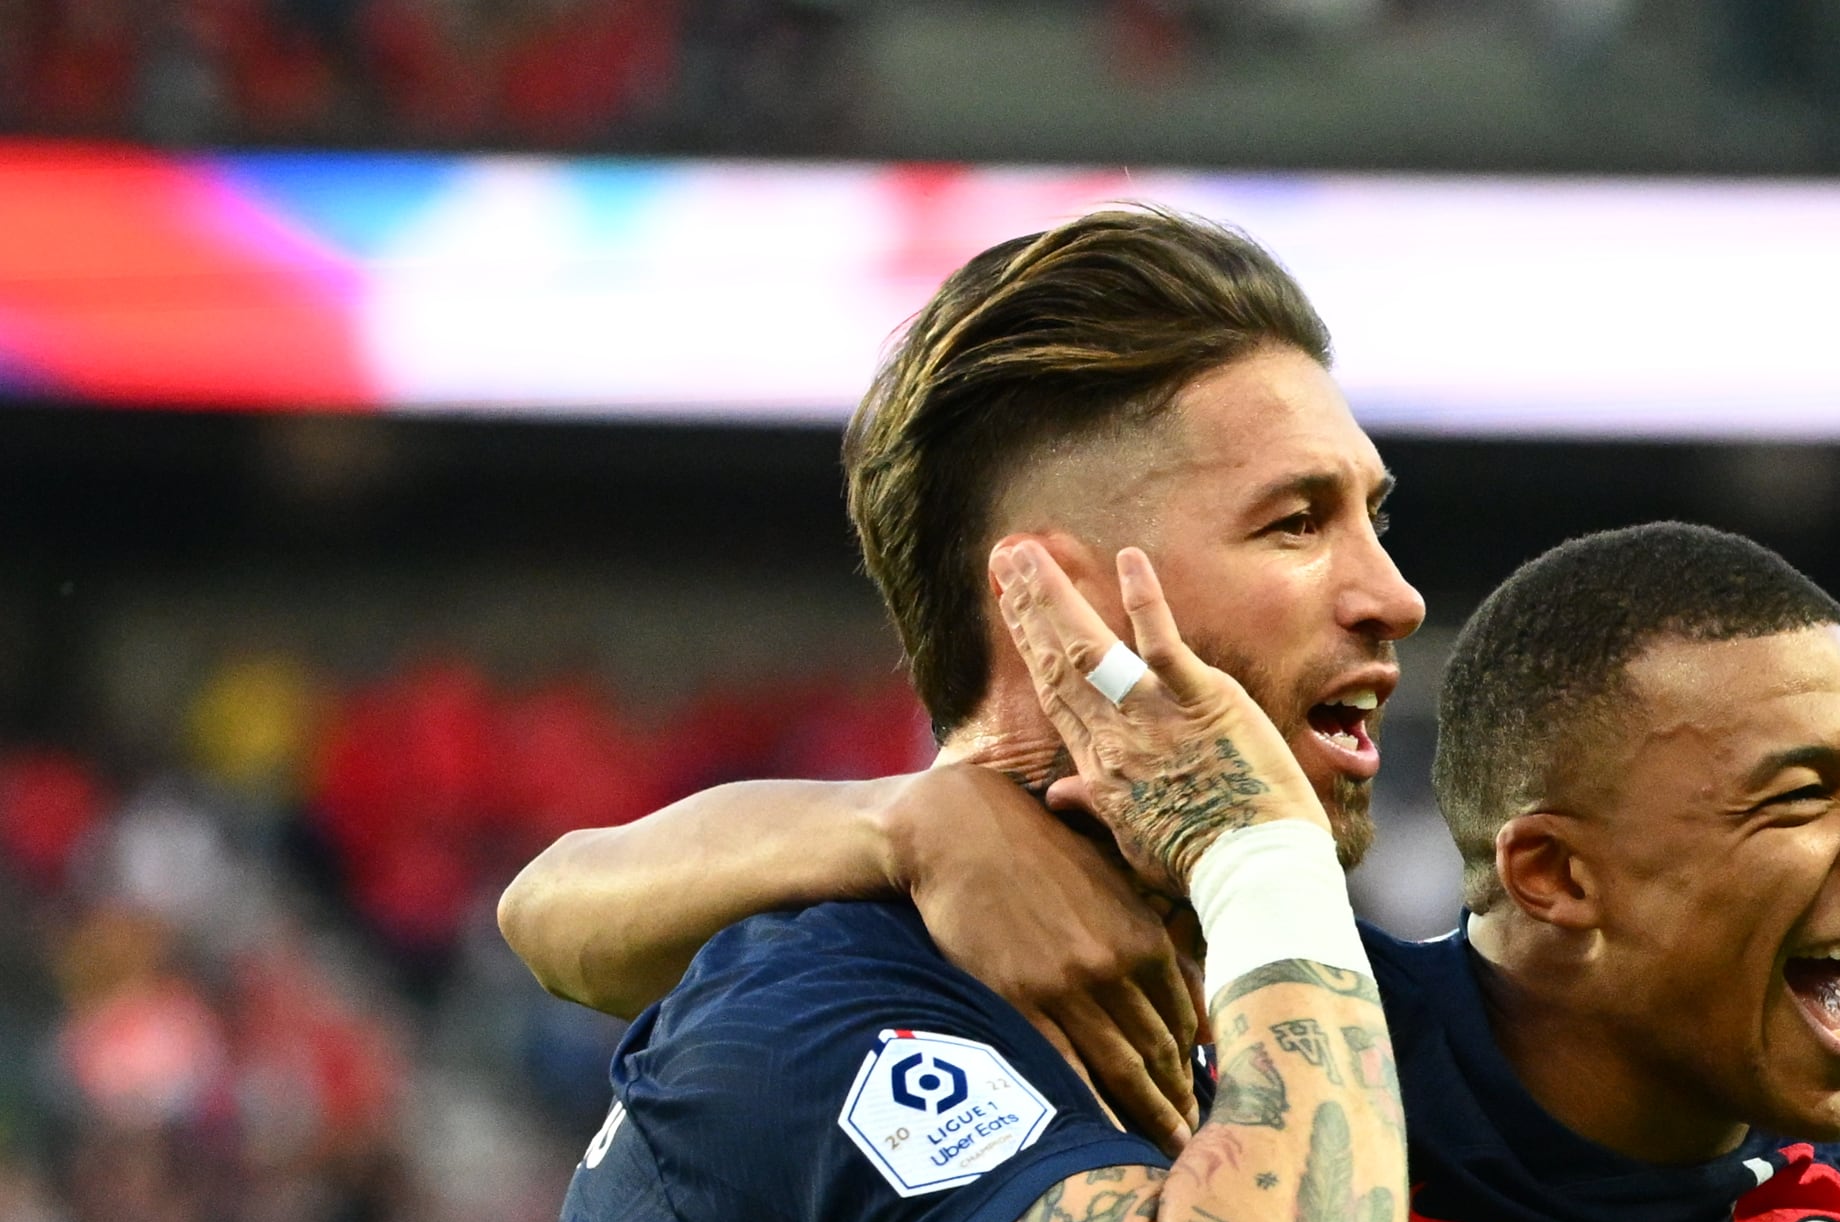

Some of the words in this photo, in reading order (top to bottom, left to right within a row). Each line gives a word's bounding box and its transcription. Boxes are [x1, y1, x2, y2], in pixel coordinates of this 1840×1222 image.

[884, 1126, 910, 1151] 20
[926, 1105, 986, 1146] LIGUE
[987, 1101, 998, 1110] 1
[930, 1134, 974, 1167] Uber
[975, 1114, 1019, 1137] Eats
